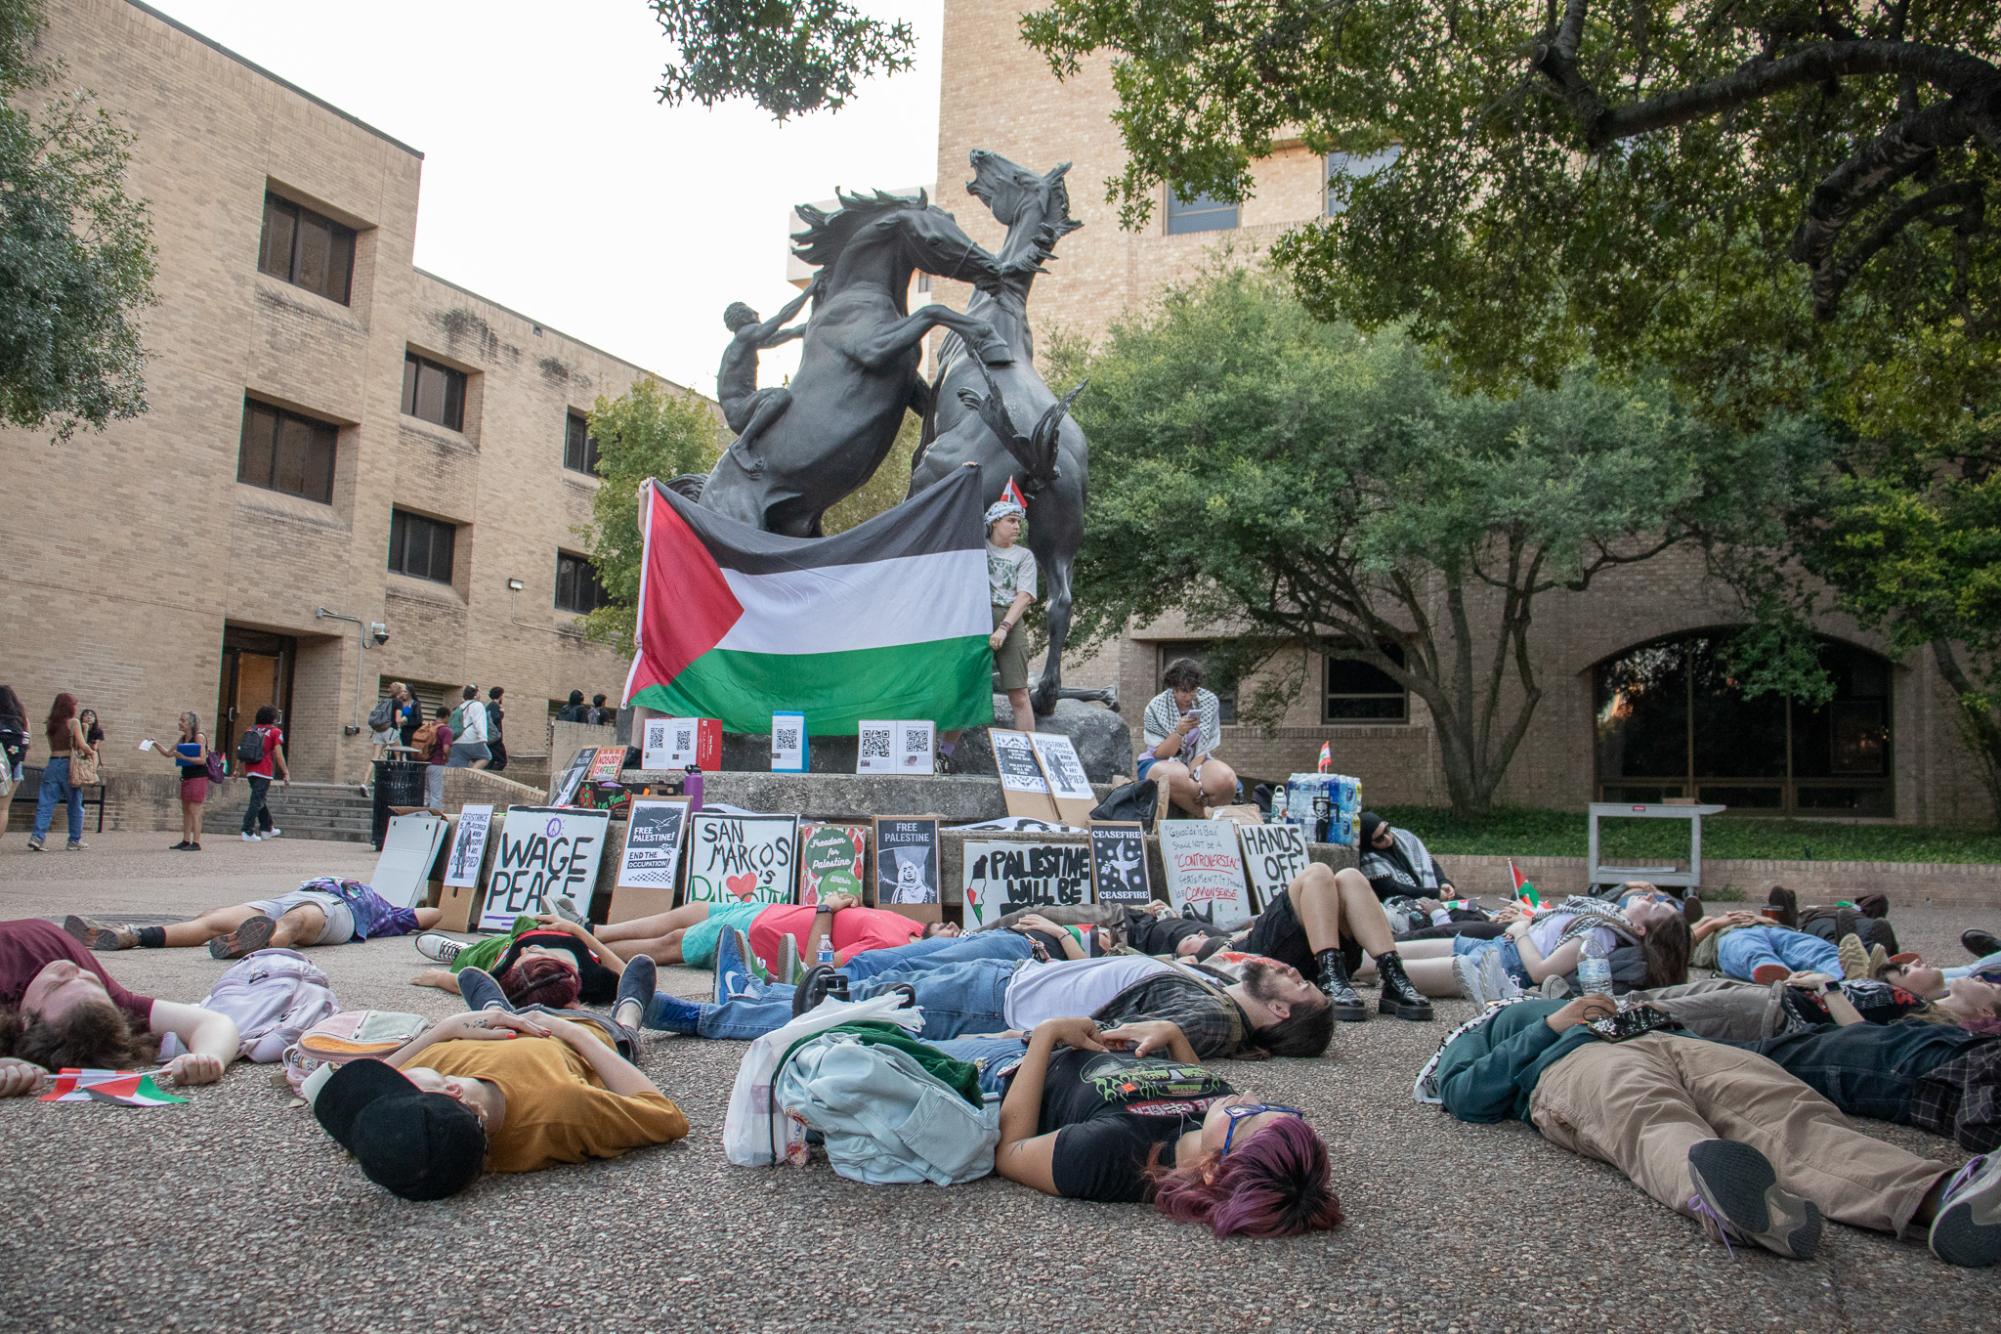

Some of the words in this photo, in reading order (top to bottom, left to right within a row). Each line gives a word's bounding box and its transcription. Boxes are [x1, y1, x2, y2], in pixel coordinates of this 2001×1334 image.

[634, 826, 653, 835] FREE
[702, 819, 743, 843] SAN
[896, 823, 917, 832] FREE
[633, 831, 675, 842] PALESTINE!
[884, 833, 929, 842] PALESTINE
[1092, 830, 1140, 839] CEASEFIRE
[810, 836, 846, 849] Freedom
[1242, 827, 1303, 855] HANDS
[502, 832, 594, 875] WAGE
[629, 852, 644, 860] END
[645, 851, 658, 859] THE
[707, 837, 790, 875] MARCOS
[827, 847, 840, 858] for
[812, 857, 852, 869] Palestine
[990, 846, 1089, 880] PALESTINE
[1007, 879, 1055, 904] WILL
[1058, 877, 1082, 904] BE
[1099, 890, 1148, 899] CEASEFIRE
